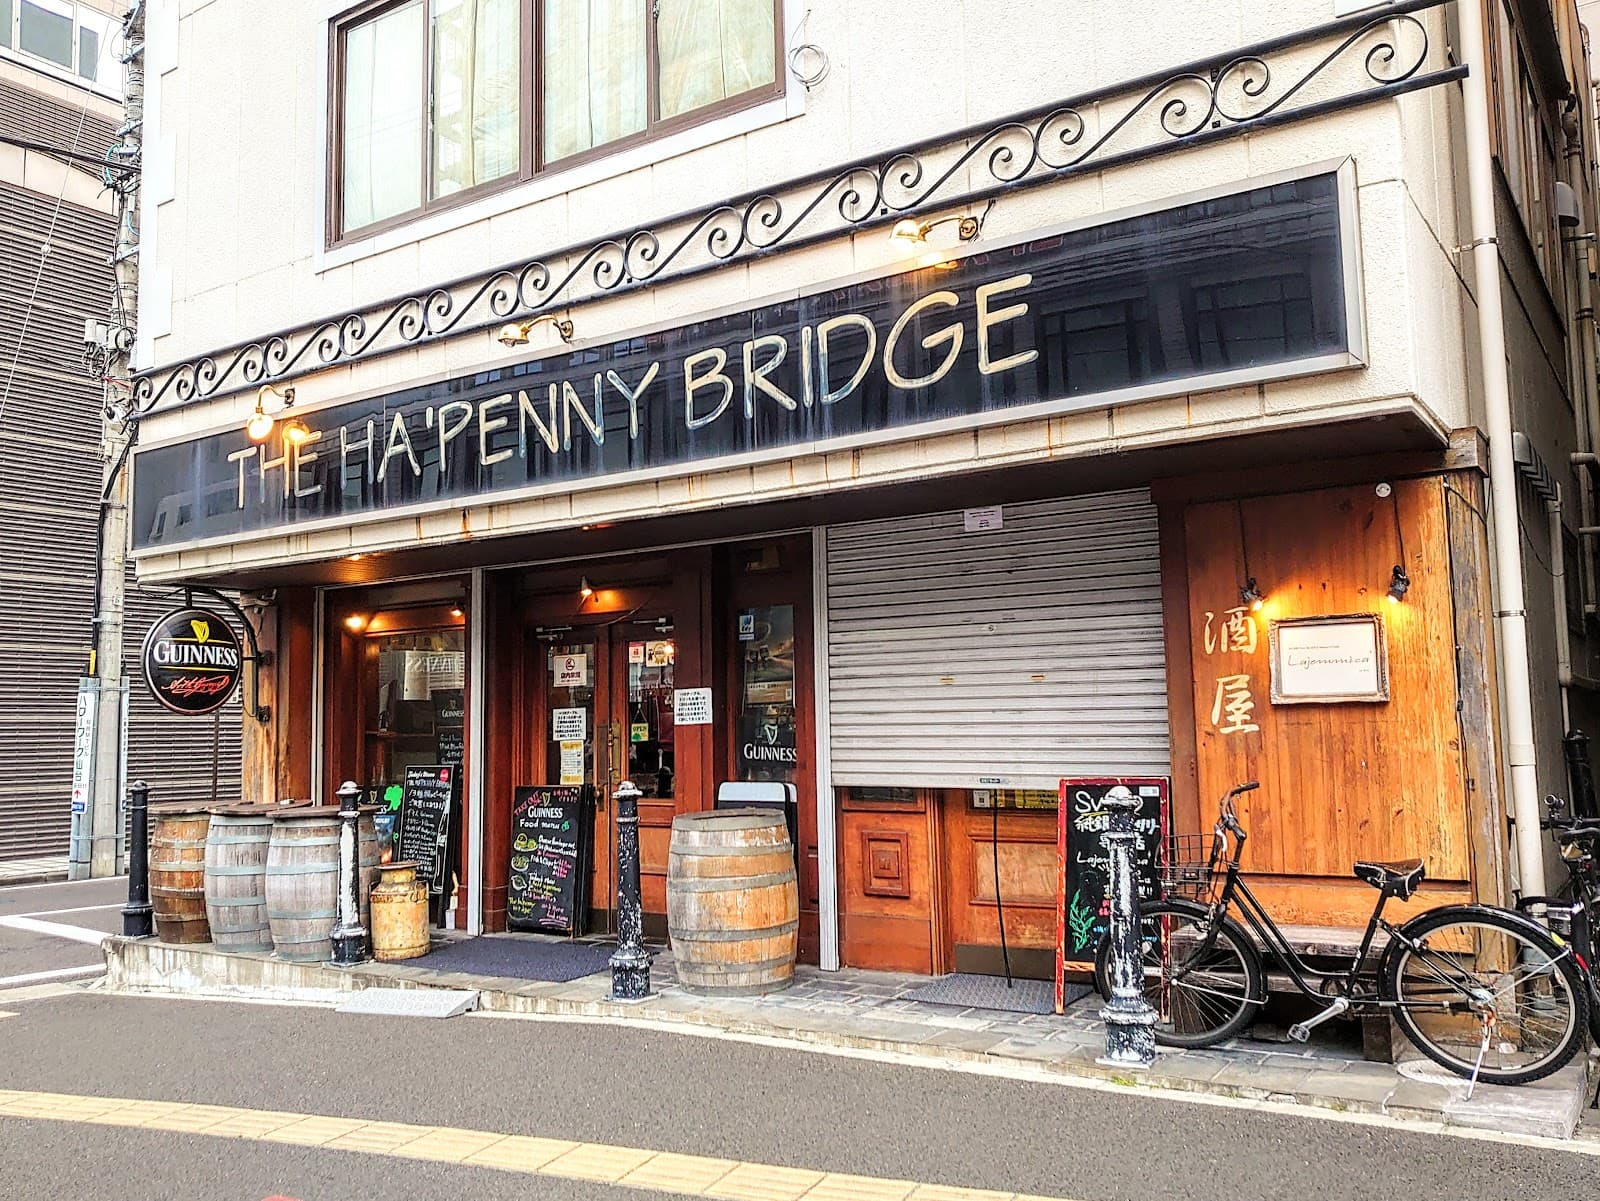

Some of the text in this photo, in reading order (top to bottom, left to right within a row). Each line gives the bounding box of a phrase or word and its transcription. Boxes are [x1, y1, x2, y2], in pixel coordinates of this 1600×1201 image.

[226, 273, 1039, 509] THE HA'PENNY BRIDGE
[153, 640, 238, 667] GUINNESS
[1204, 606, 1260, 734] 酒屋
[743, 743, 797, 762] GUINNESS
[520, 818, 539, 828] Food
[527, 805, 563, 818] GUINNESS
